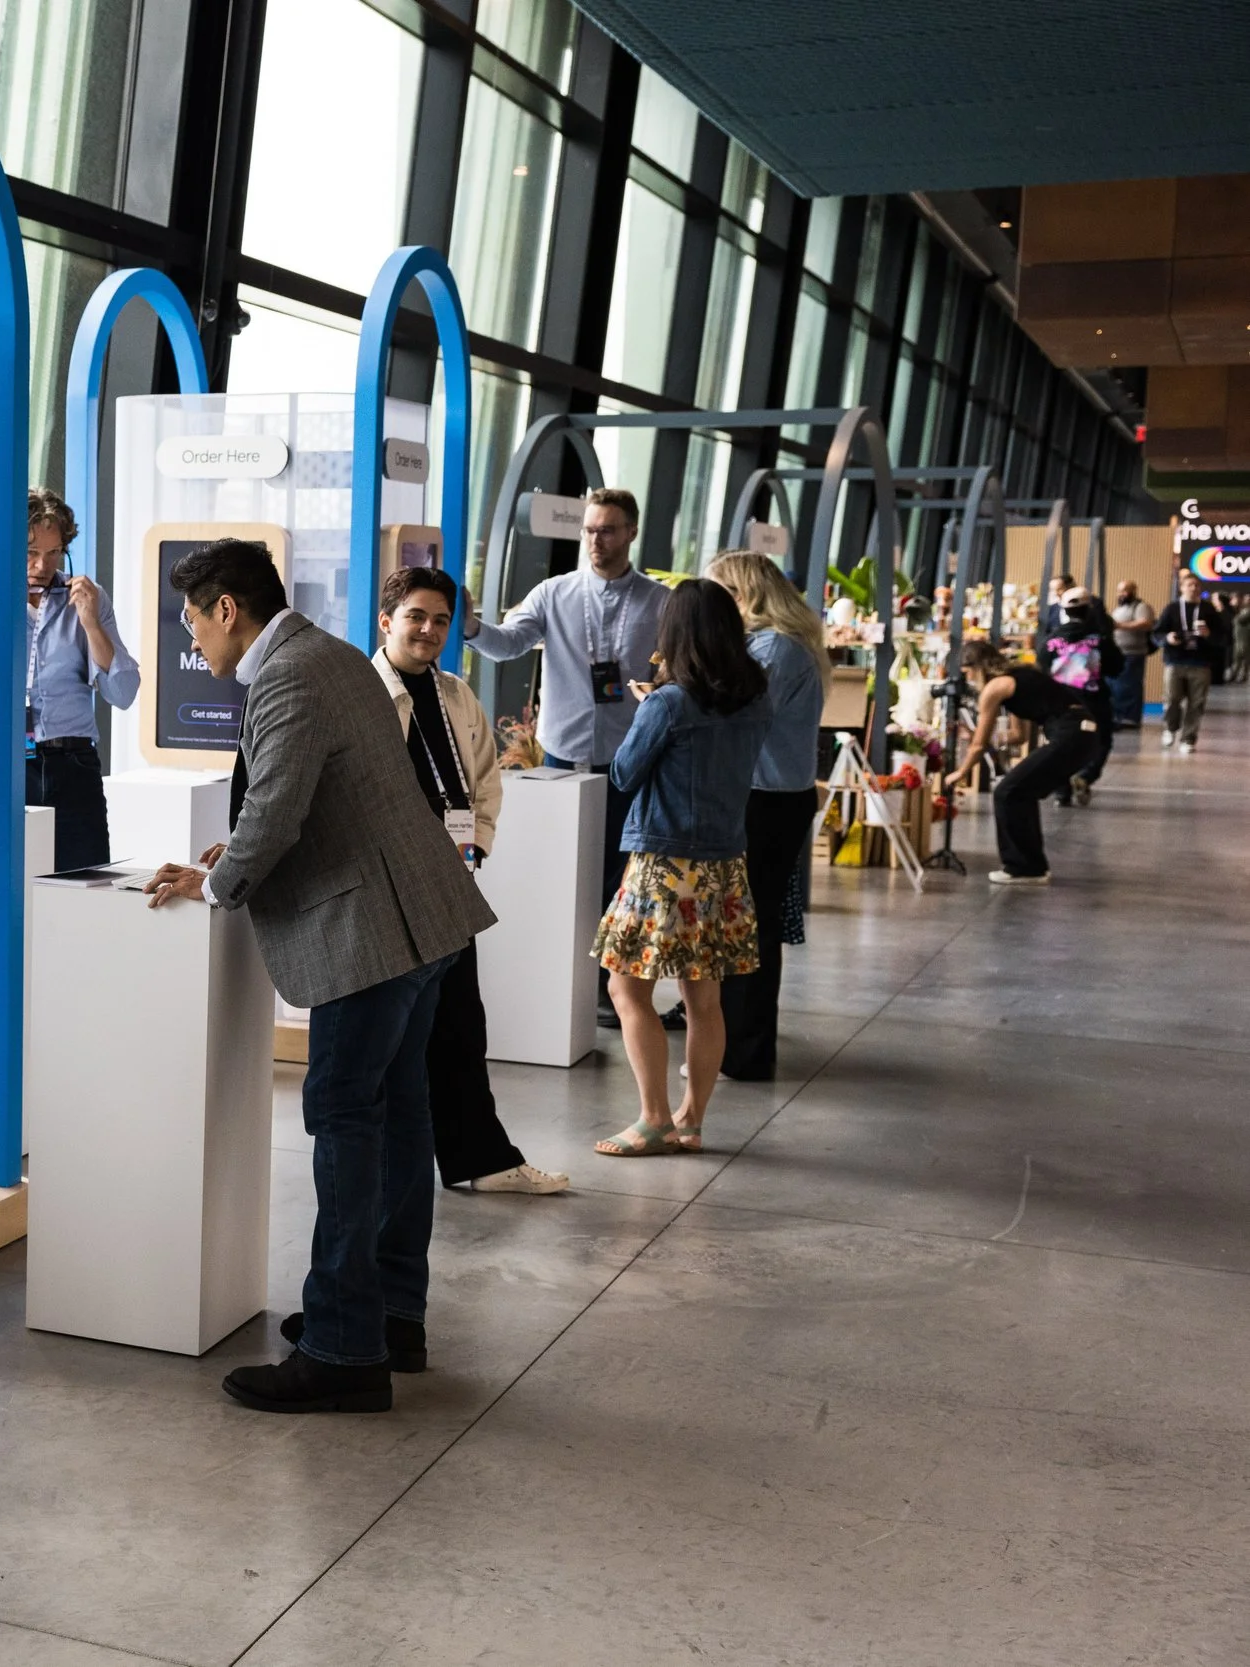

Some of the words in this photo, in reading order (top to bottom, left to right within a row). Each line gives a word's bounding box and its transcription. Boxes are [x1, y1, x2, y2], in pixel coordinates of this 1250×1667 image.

[182, 449, 223, 464] Order
[226, 449, 260, 463] Here
[395, 451, 410, 467] Order
[410, 454, 422, 470] Here
[1214, 523, 1250, 541] wo
[180, 652, 211, 671] Ma
[191, 709, 206, 719] Get
[206, 710, 232, 720] started
